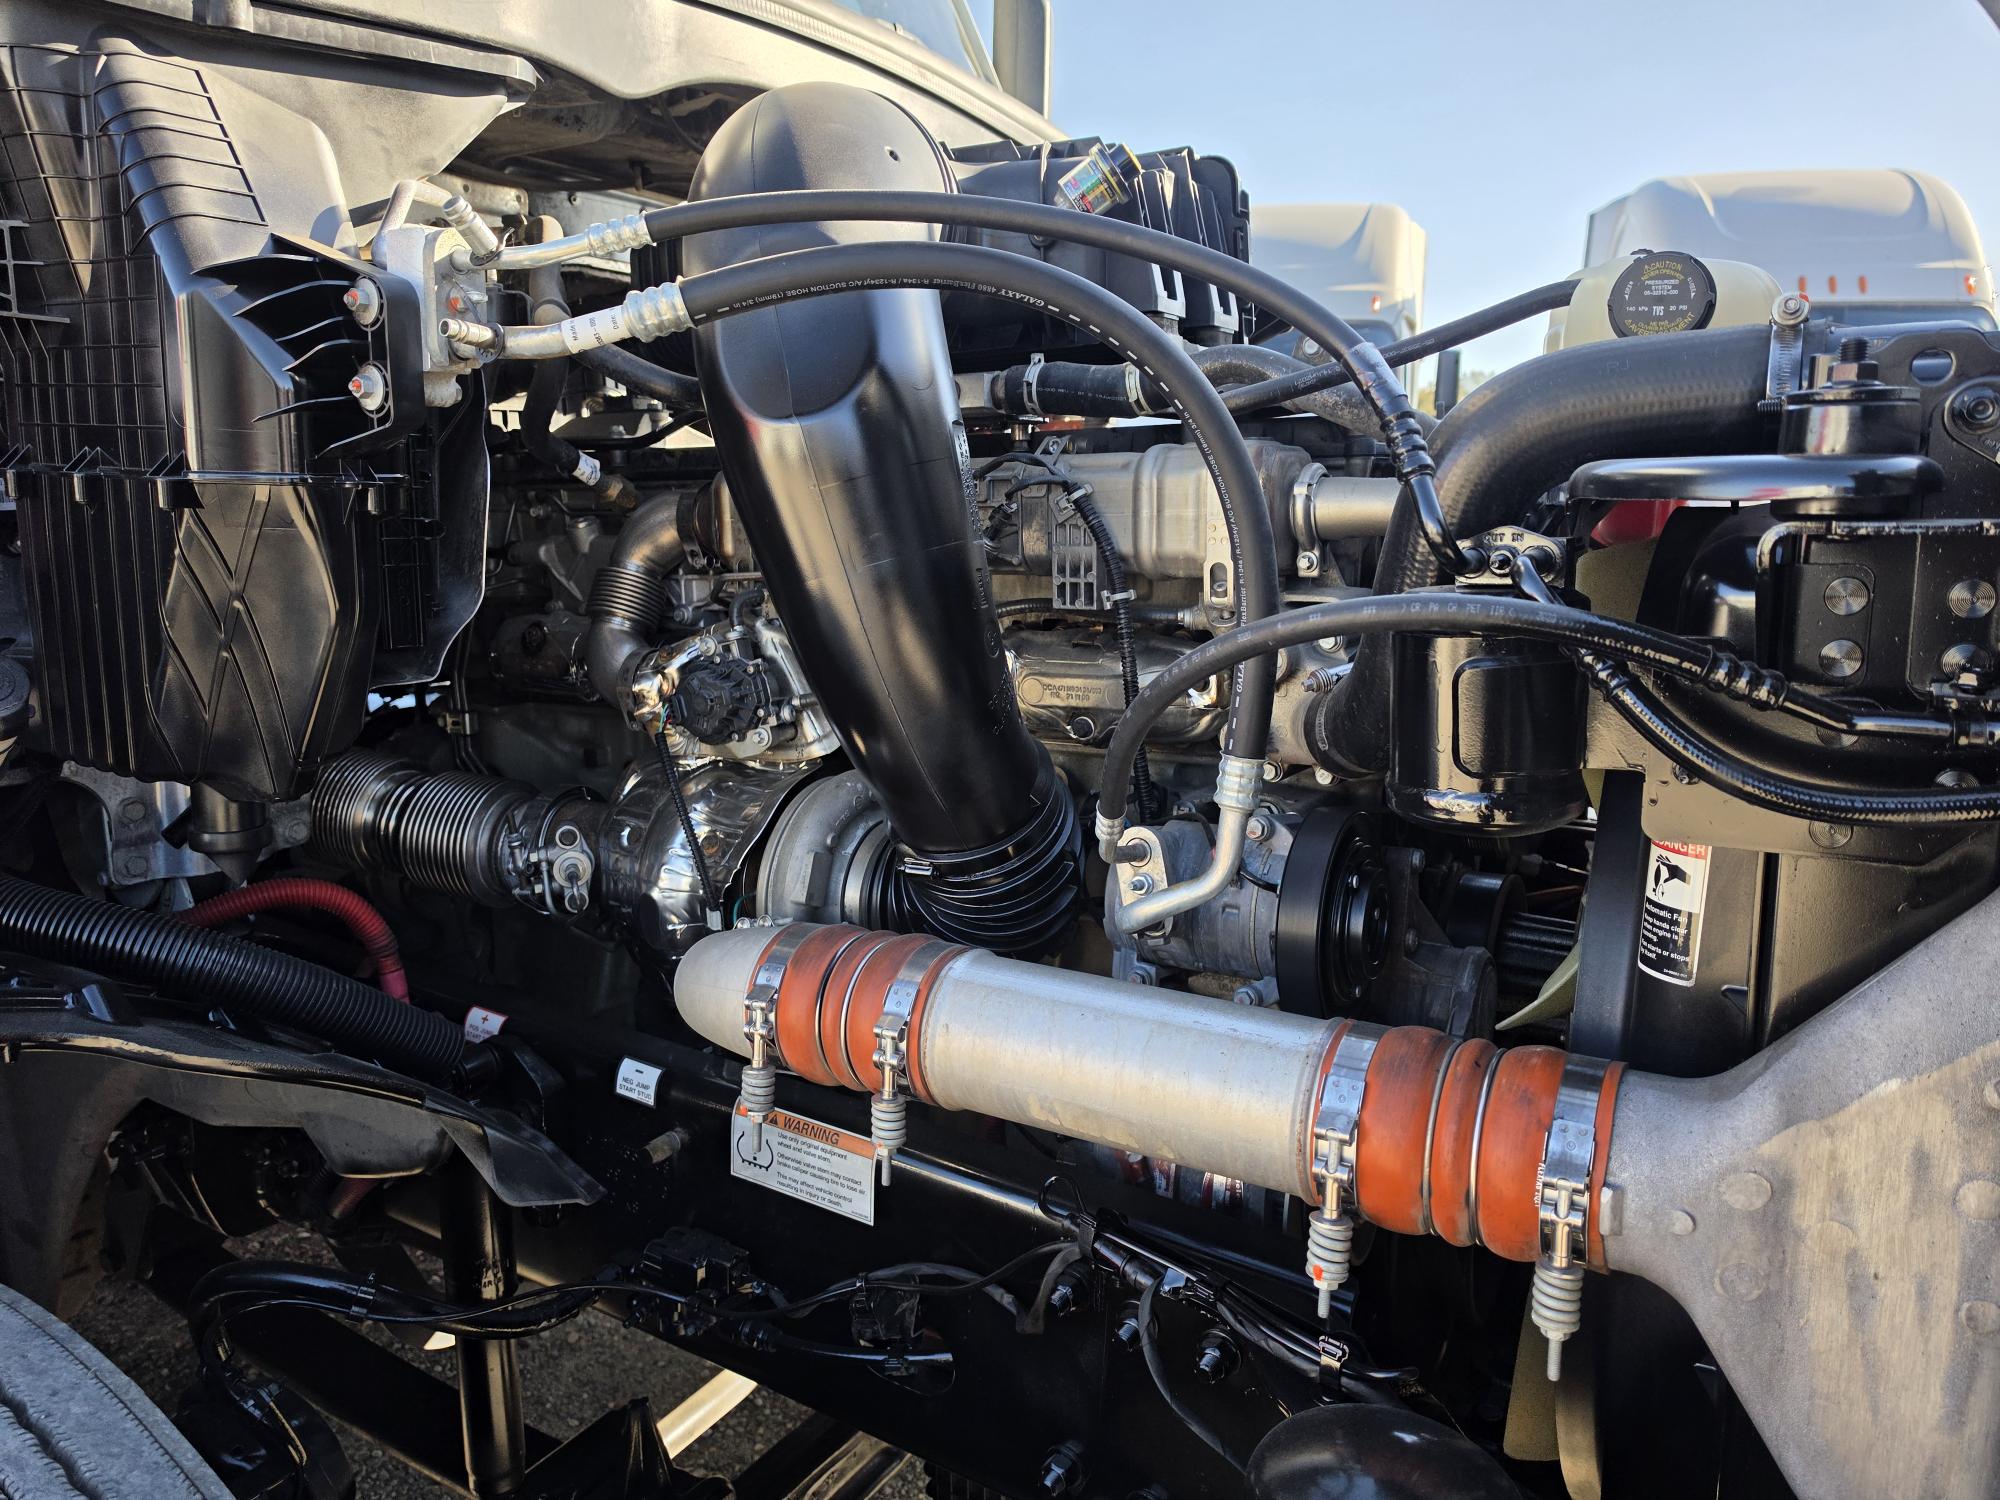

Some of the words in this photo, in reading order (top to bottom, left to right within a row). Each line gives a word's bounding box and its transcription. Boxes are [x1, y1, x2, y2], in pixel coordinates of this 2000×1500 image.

[1650, 261, 1682, 271] CAUTION
[810, 282, 846, 292] SUCTION
[864, 278, 896, 286] R-1234yf
[932, 278, 976, 290] FlexBarrier
[978, 284, 996, 292] 4880
[755, 292, 784, 304] (19mm)
[786, 288, 809, 297] HOSE
[998, 288, 1045, 307] GALAXY
[1653, 306, 1664, 316] TVS
[1188, 418, 1197, 430] 3/4
[1195, 429, 1212, 455] (19mm)
[1208, 455, 1219, 476] HOSE
[1217, 476, 1232, 509] SUCTION
[1228, 510, 1236, 523] A/C
[1512, 532, 1524, 542] IN
[1236, 662, 1245, 692] GALA
[1646, 901, 1672, 918] Automatic
[1673, 914, 1688, 923] Fan
[1653, 928, 1671, 938] engine
[1654, 918, 1670, 930] hands
[1671, 926, 1688, 934] clear
[1648, 943, 1661, 954] starts
[1671, 953, 1689, 961] stops
[622, 1076, 633, 1085] NEG
[636, 1081, 650, 1090] JUMP
[619, 1084, 636, 1094] START
[638, 1090, 651, 1100] STUD
[784, 1116, 840, 1145] WARNING
[777, 1141, 791, 1149] wheel
[803, 1150, 817, 1158] valve
[818, 1154, 831, 1163] stem.
[778, 1132, 788, 1140] Use
[789, 1136, 800, 1145] only
[801, 1140, 819, 1150] original
[820, 1147, 847, 1160] equipment
[777, 1152, 802, 1166] Otherwise
[803, 1161, 816, 1170] valve
[817, 1166, 830, 1175] stem
[831, 1170, 842, 1179] may
[842, 1174, 862, 1186] contact
[777, 1160, 790, 1170] brake
[791, 1165, 808, 1176] caliper
[810, 1171, 830, 1184] causing
[830, 1176, 839, 1186] tire
[840, 1180, 846, 1188] to
[846, 1184, 858, 1192] lose
[777, 1172, 788, 1180] This
[788, 1176, 799, 1185] may
[800, 1180, 814, 1189] affect
[815, 1186, 833, 1197] vehicle
[834, 1192, 852, 1203] control
[777, 1180, 798, 1193] resulting
[805, 1189, 820, 1200] injury
